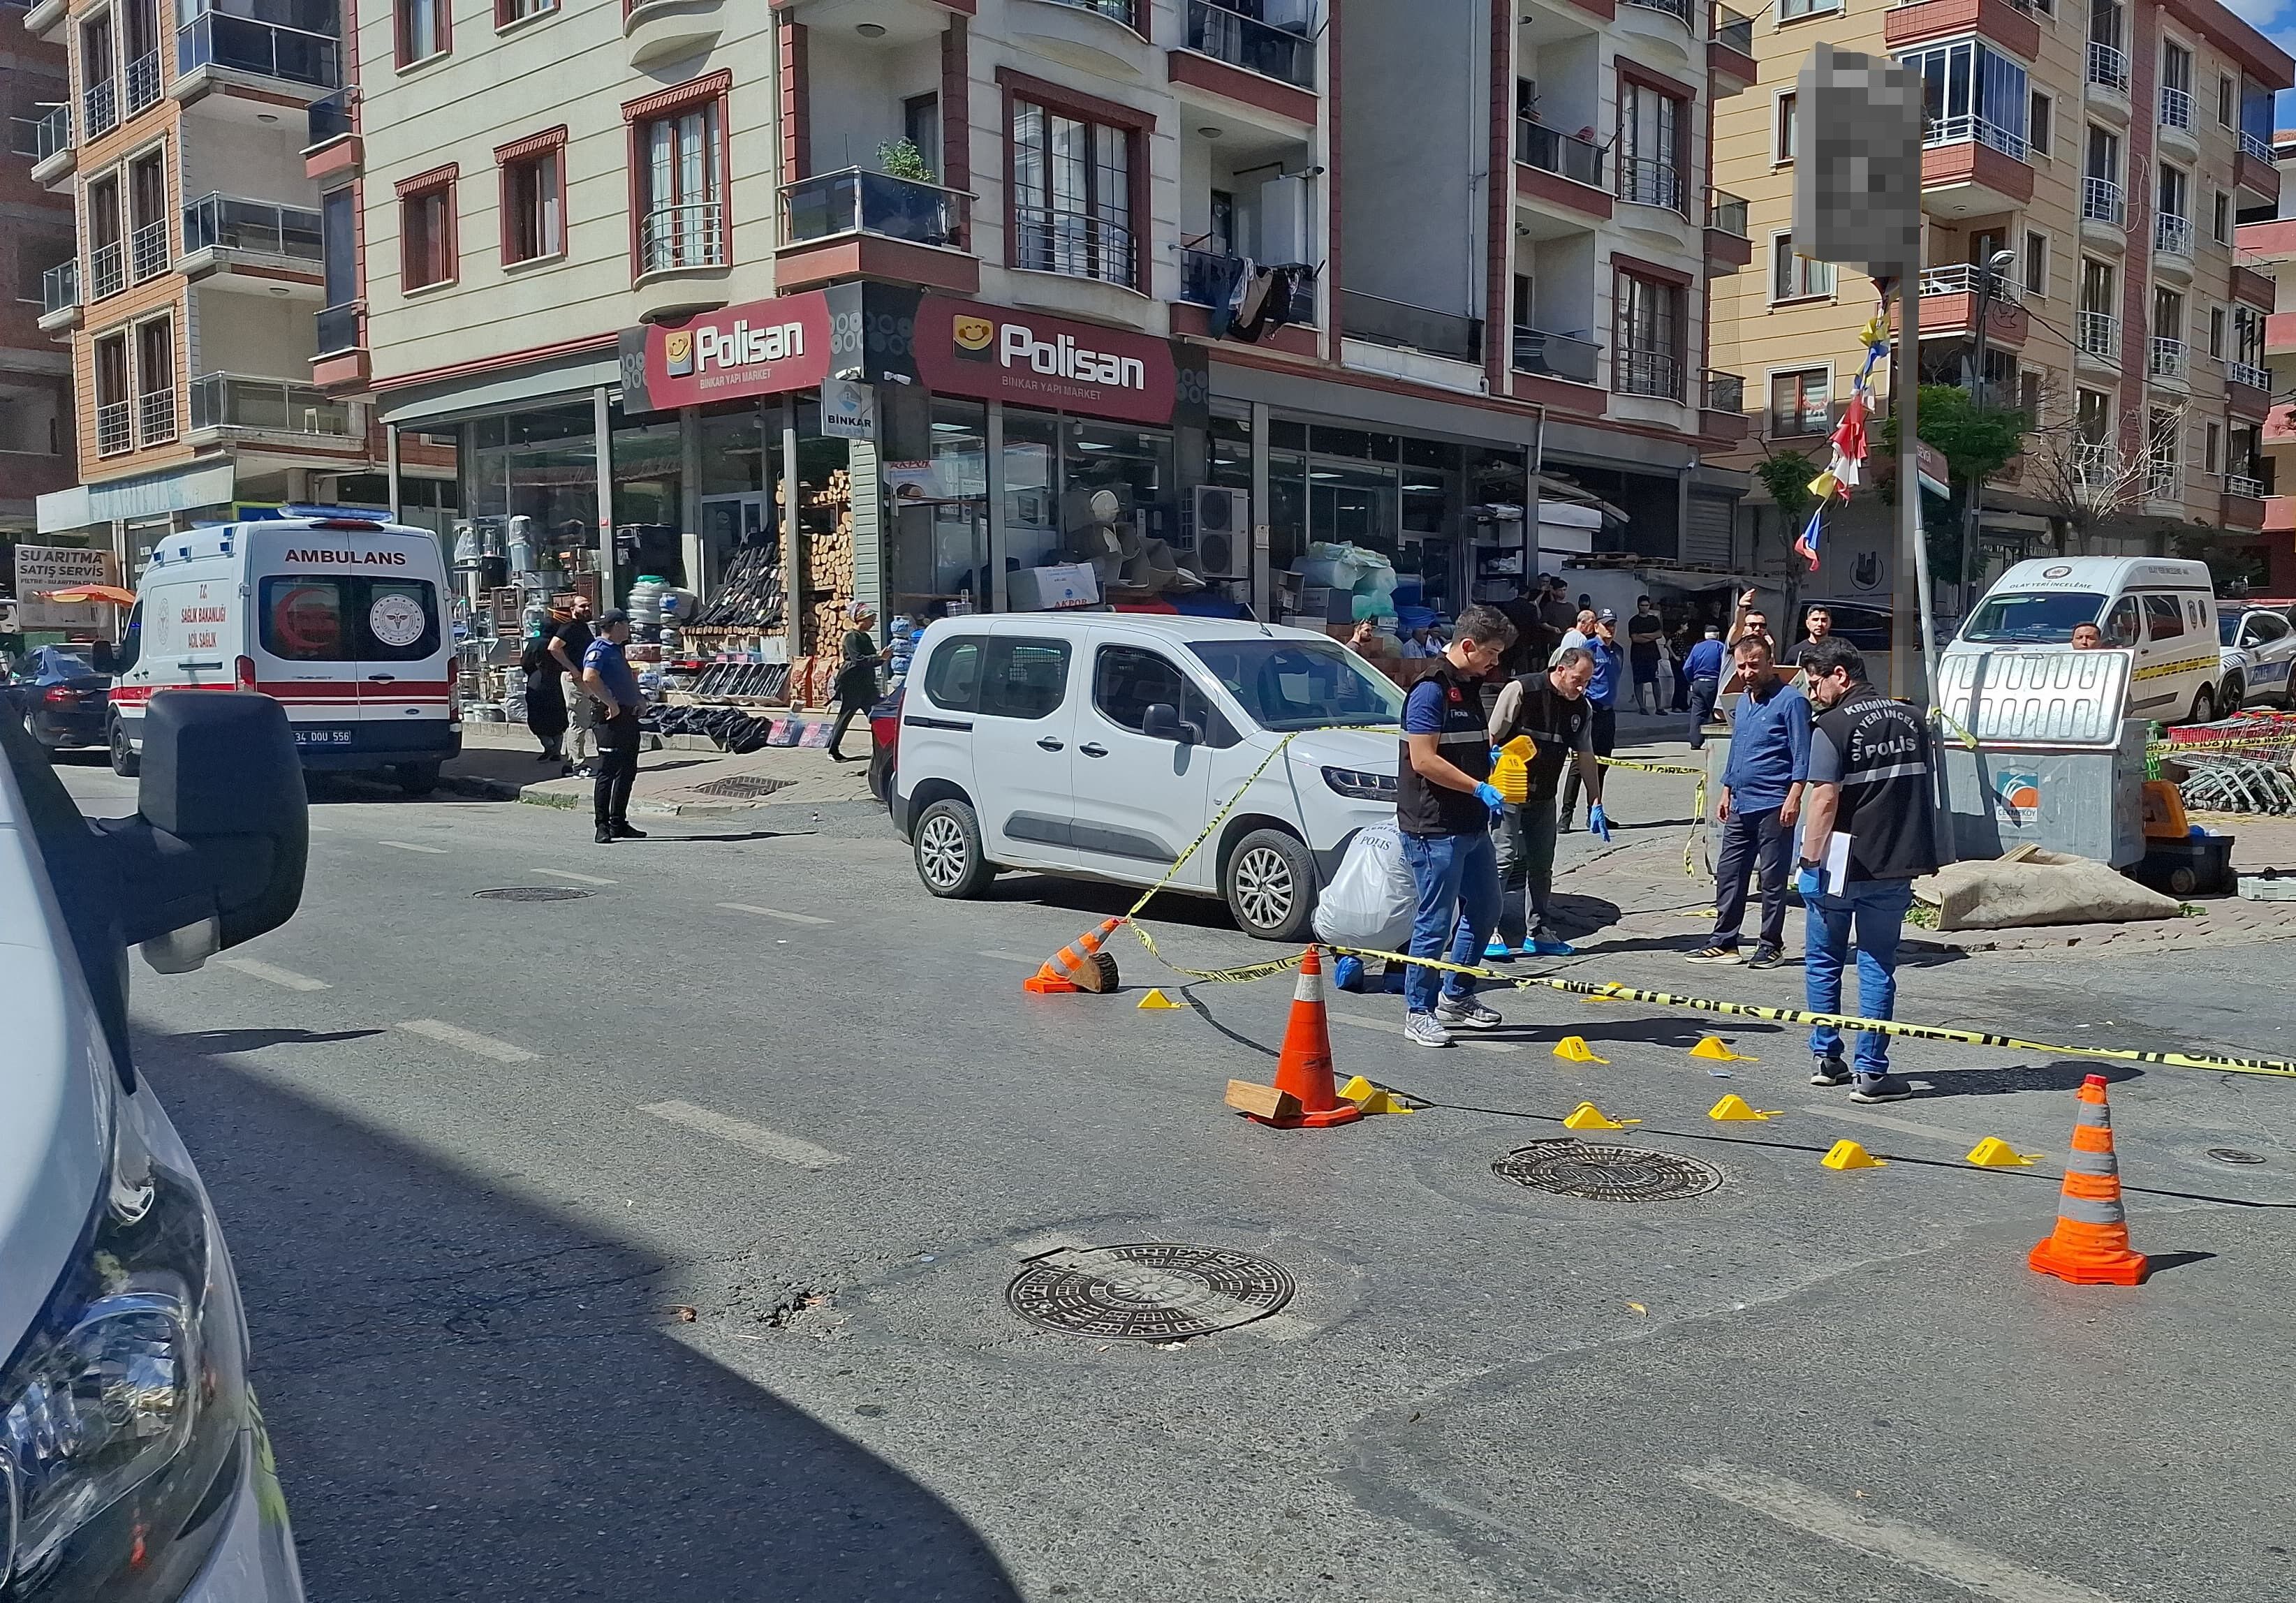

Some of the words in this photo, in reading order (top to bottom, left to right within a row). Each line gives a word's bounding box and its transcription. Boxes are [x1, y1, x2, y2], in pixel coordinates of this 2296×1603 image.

[697, 319, 804, 372] Polisan
[1000, 323, 1145, 390] Polisan
[726, 372, 742, 385] YAPI
[742, 368, 772, 382] MARKET
[1040, 382, 1061, 395] YAPI
[1064, 386, 1101, 401] MARKET
[827, 413, 871, 427] BİNKAR
[20, 550, 41, 561] SU
[285, 549, 406, 565] AMBULANS
[20, 565, 56, 578] SATIŞ
[59, 564, 103, 577] SERVİS
[181, 605, 198, 623] SAĞLIK
[198, 603, 226, 623] BAKANLIĞI
[1844, 698, 1906, 716] KRİMİNA
[295, 732, 306, 741] 34
[333, 732, 349, 741] 556
[1851, 729, 1864, 762] OLAY
[1859, 709, 1882, 729] YERİ
[1883, 708, 1919, 734] İNCEL
[1865, 735, 1916, 759] POLİS
[1575, 1042, 1582, 1053] 9
